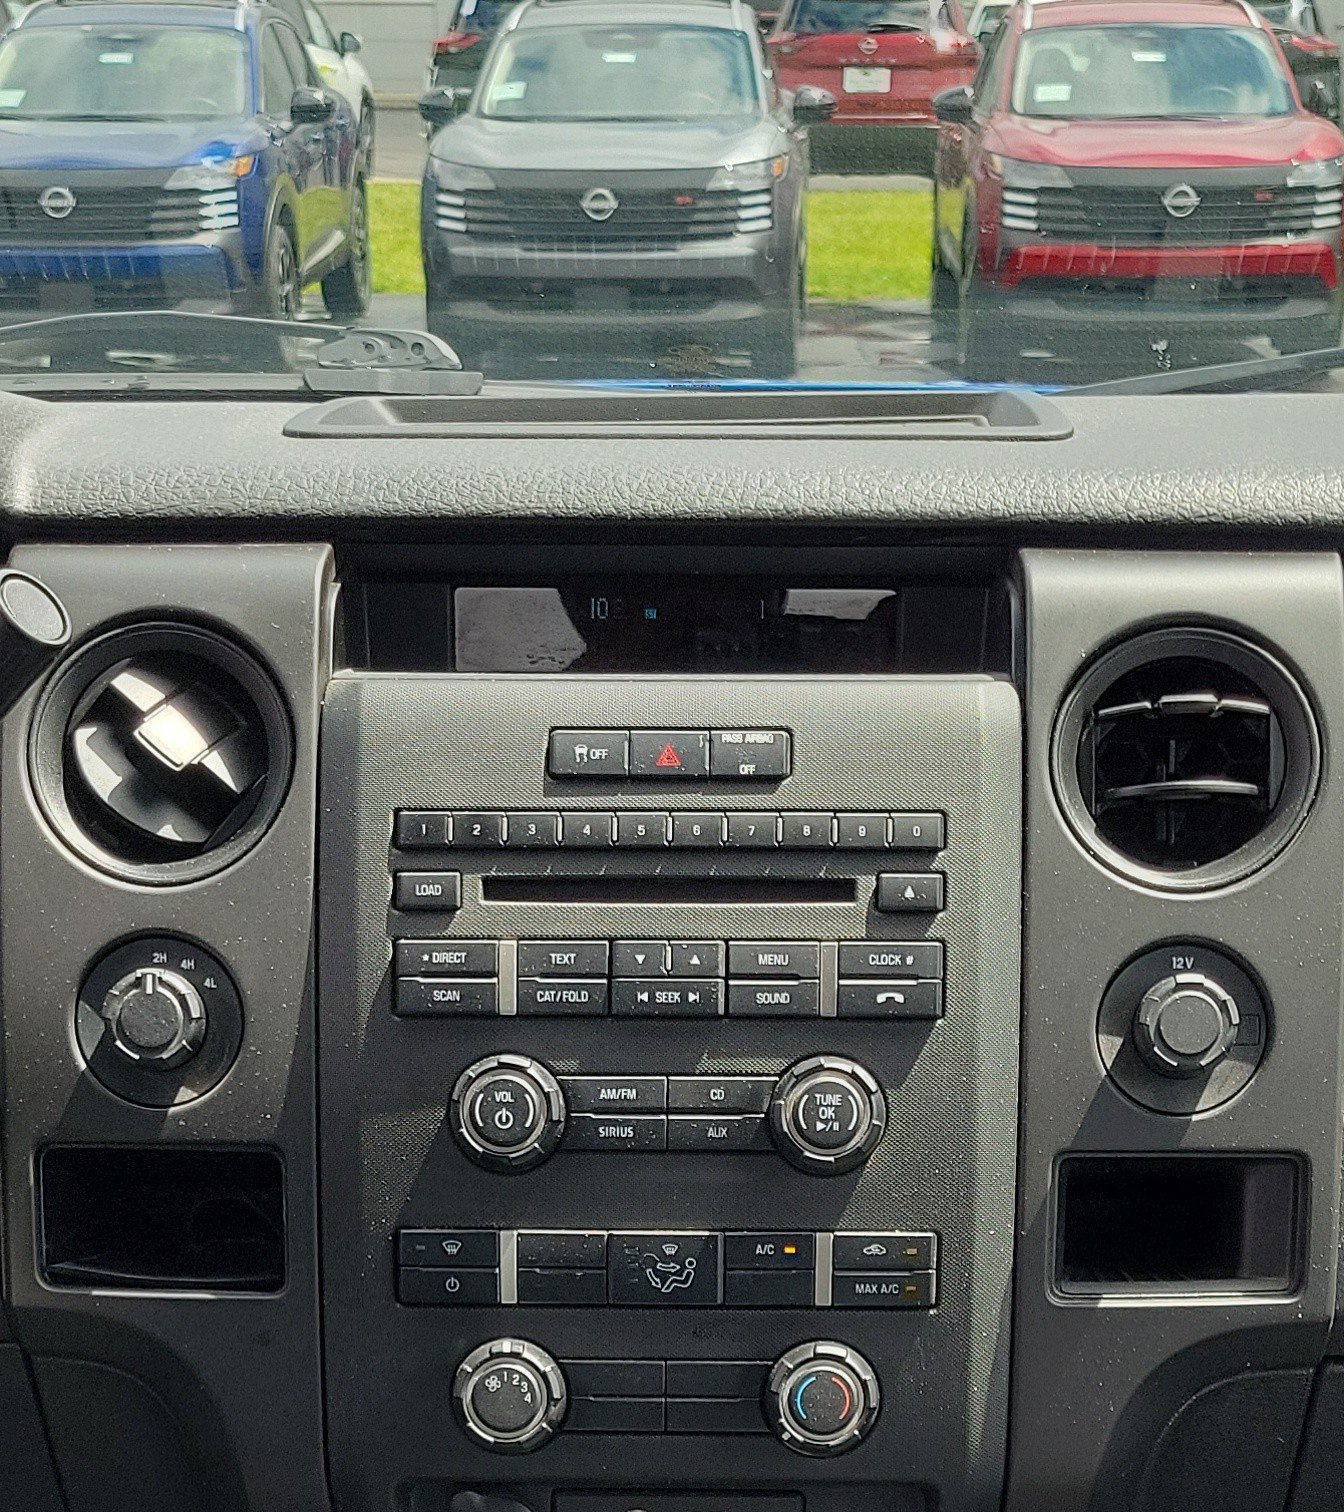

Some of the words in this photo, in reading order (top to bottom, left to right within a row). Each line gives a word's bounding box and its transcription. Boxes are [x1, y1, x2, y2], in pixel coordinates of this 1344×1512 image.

[590, 749, 608, 760] OFF
[739, 764, 756, 775] OFF
[472, 824, 481, 836] 2
[528, 824, 536, 836] 3
[582, 824, 591, 836] 4
[637, 824, 646, 836] 5
[692, 826, 700, 836] 6
[748, 826, 756, 836] 7
[802, 826, 810, 836] 8
[858, 826, 866, 837] 9
[912, 826, 920, 837] 0
[414, 884, 442, 896] LOAD
[153, 953, 167, 964] 2H
[181, 958, 195, 970] 4H
[432, 952, 466, 965] DIRECT
[550, 952, 576, 966] TEXT
[758, 954, 789, 966] MENU
[868, 954, 902, 966] CLOCK
[1171, 957, 1194, 969] 12V
[204, 978, 217, 988] 4L
[432, 990, 460, 1002] SCAN
[536, 990, 589, 1004] CAT/FOLD
[655, 992, 681, 1004] SEEK
[756, 992, 790, 1005] SOUND
[494, 1091, 514, 1104] VOL
[599, 1088, 637, 1101] AM/FM
[710, 1088, 724, 1100] CD
[814, 1094, 842, 1108] TUNE
[818, 1106, 836, 1119] OK
[598, 1126, 634, 1138] SIRIUS
[706, 1126, 728, 1139] AUX
[754, 1244, 775, 1256] A/C
[856, 1282, 878, 1294] MAX
[880, 1283, 900, 1296] A/C
[512, 1374, 520, 1386] 2
[520, 1382, 528, 1392] 3
[524, 1392, 532, 1404] 4
